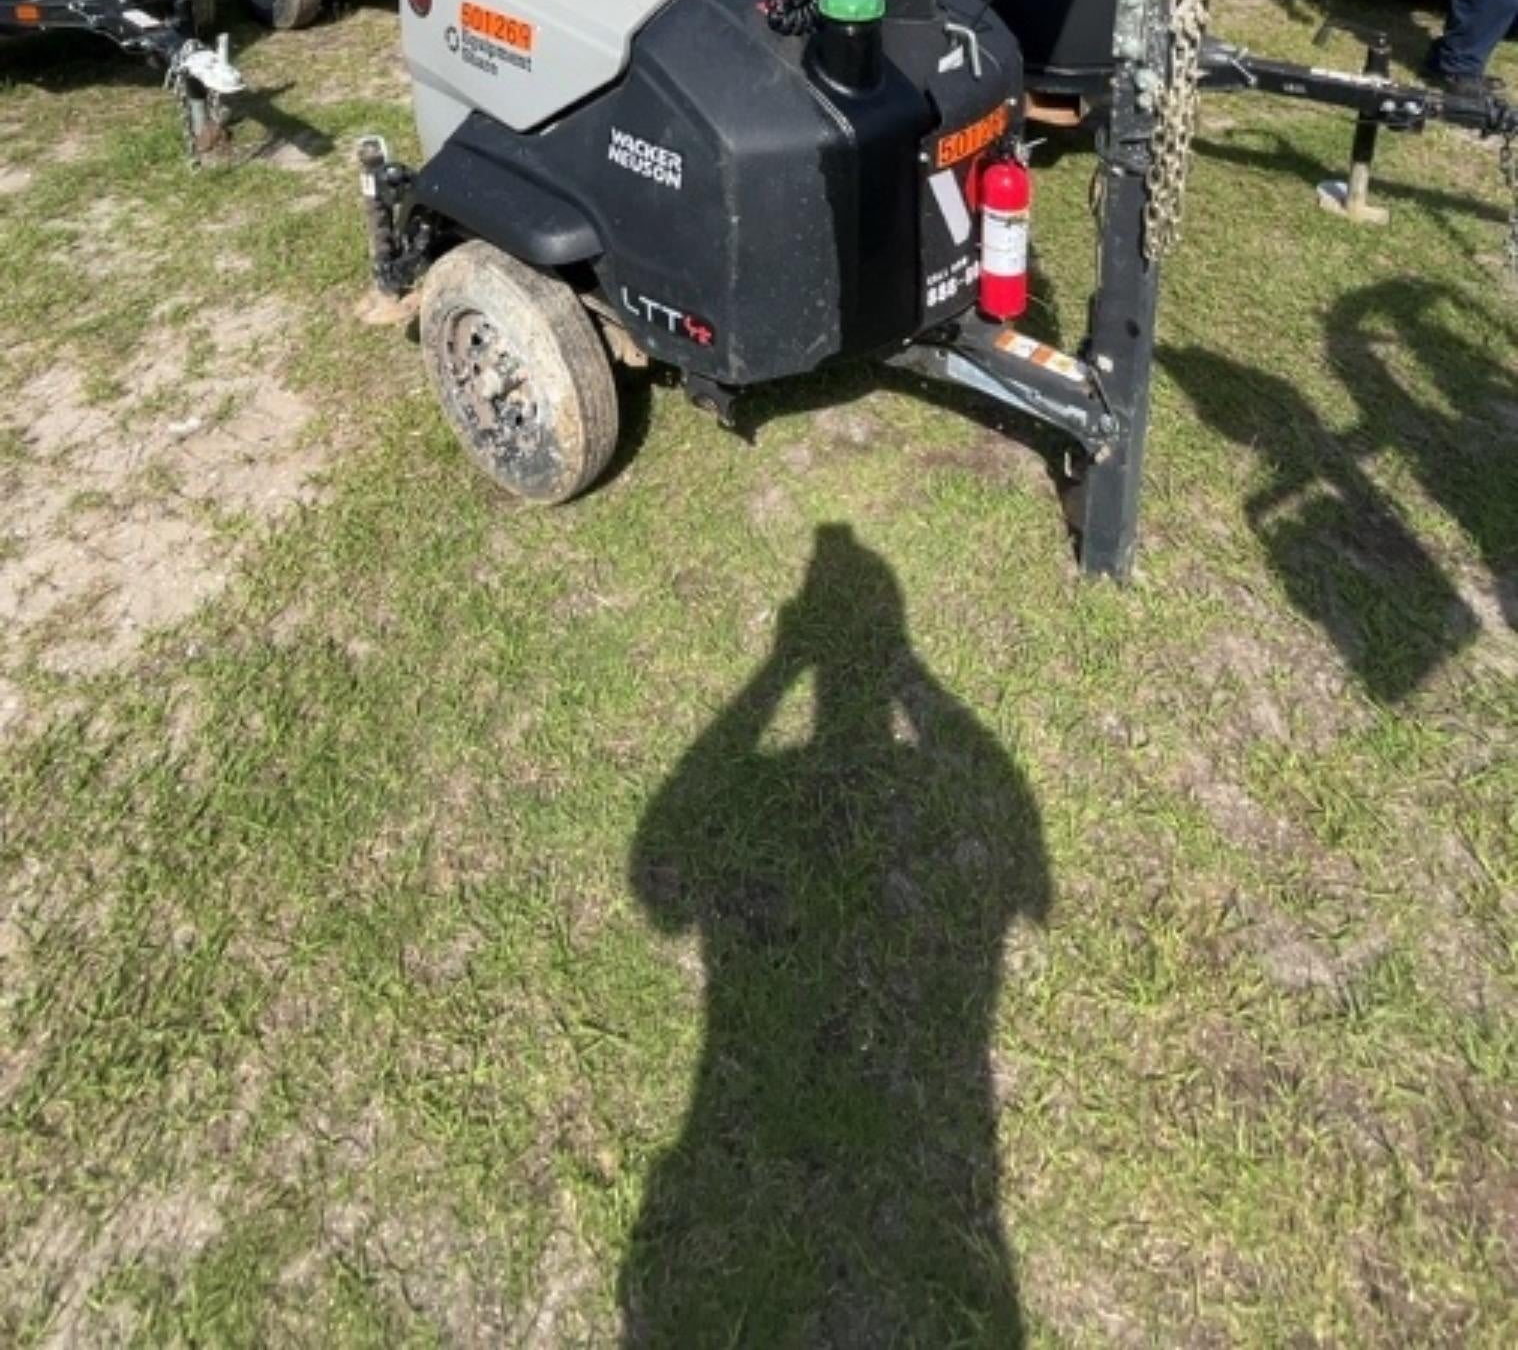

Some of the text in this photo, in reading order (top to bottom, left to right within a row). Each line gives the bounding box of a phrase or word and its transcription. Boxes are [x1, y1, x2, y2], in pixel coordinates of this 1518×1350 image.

[461, 2, 532, 51] 501269
[608, 143, 682, 190] NEUSON
[610, 126, 683, 173] WACKER
